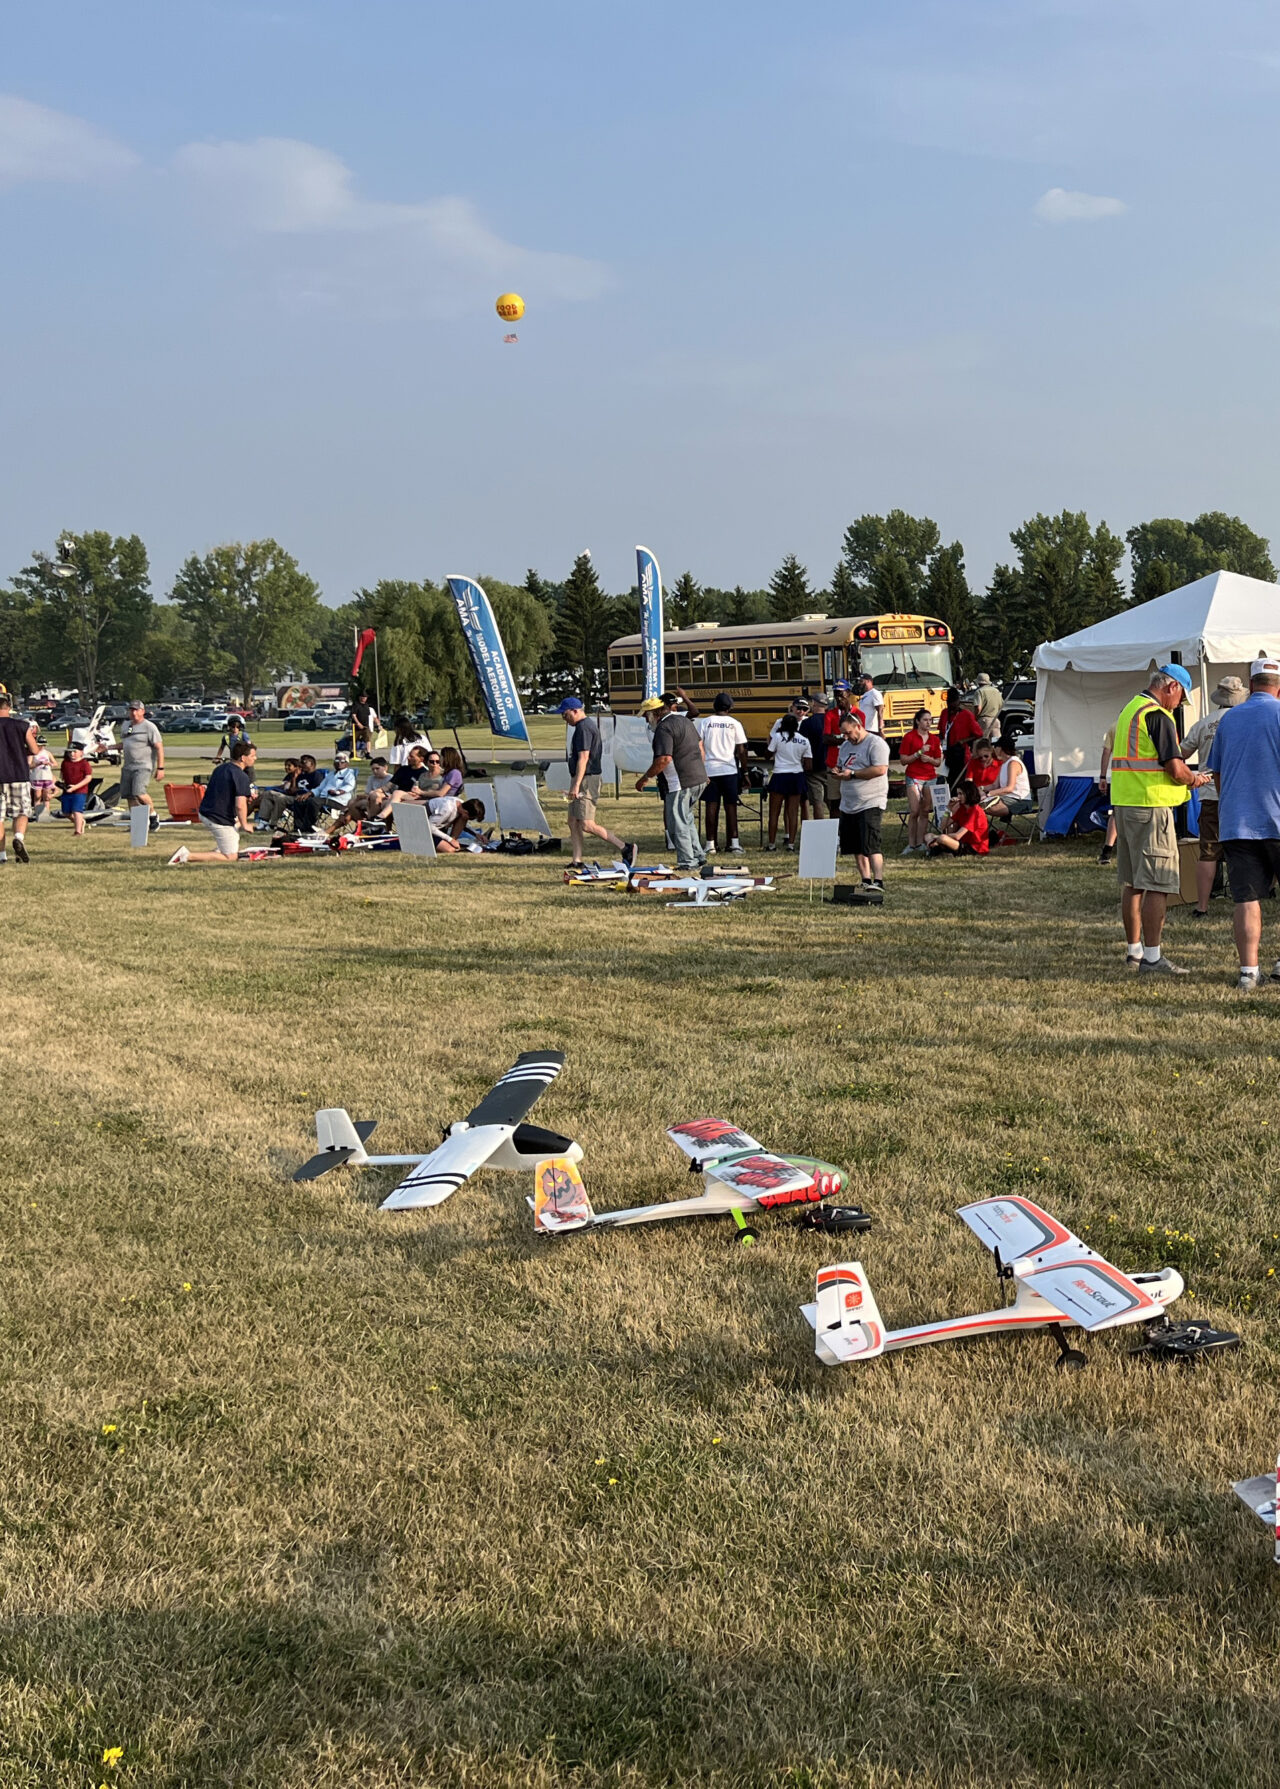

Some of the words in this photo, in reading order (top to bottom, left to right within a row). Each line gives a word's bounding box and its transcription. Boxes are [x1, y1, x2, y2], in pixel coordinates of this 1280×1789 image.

[456, 598, 470, 626] AMA
[475, 632, 491, 665] MODEL
[485, 666, 511, 732] AERONAUTICS
[490, 650, 511, 694] ACADEMY
[504, 697, 514, 710] OF
[1072, 1279, 1116, 1308] AeroScout
